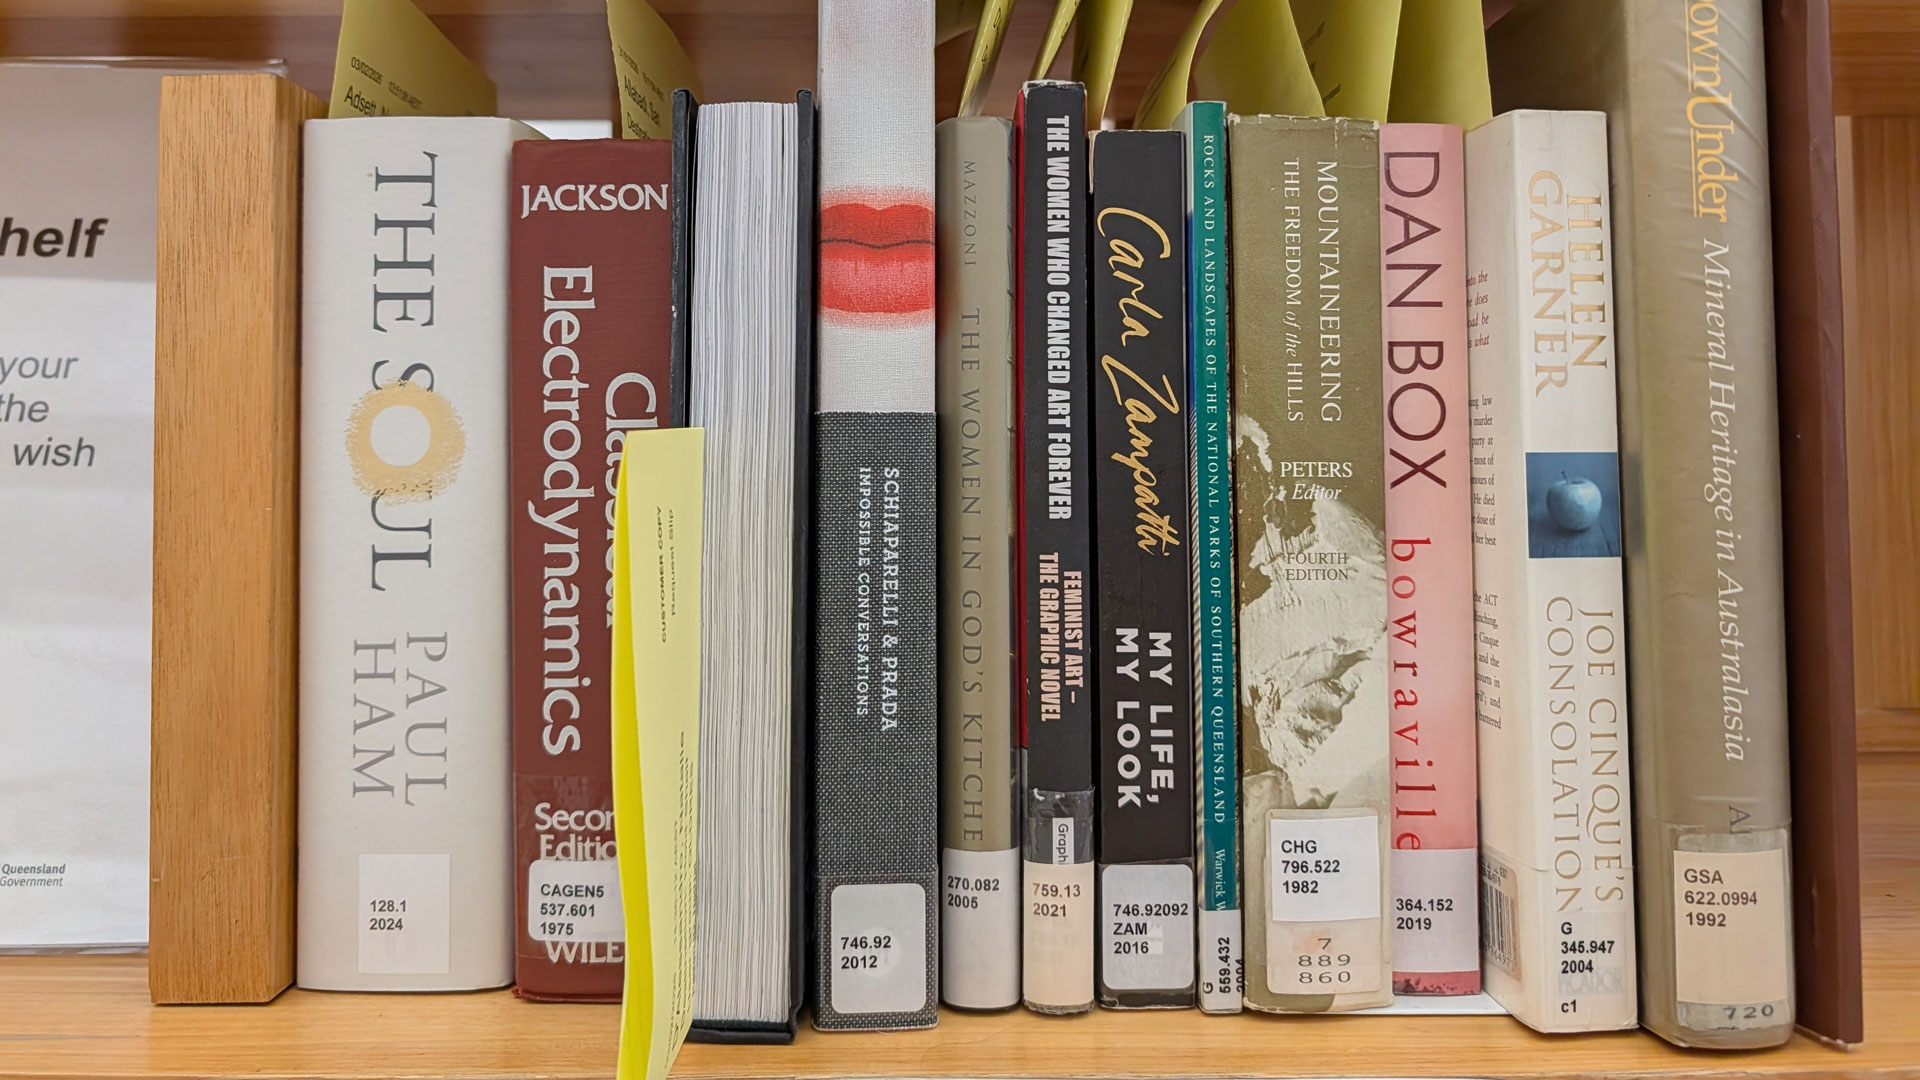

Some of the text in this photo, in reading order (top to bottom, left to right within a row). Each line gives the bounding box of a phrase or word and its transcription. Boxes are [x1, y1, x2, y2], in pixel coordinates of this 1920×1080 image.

[521, 184, 668, 219] JACKSON
[963, 160, 977, 266] MAZZONI
[0, 217, 109, 258] helf
[1478, 269, 1488, 284] the
[1528, 170, 1568, 397] GARNER
[1567, 194, 1608, 369] HELEN
[1283, 157, 1303, 422] THE FREEDOM of the HILLS
[1317, 160, 1342, 422] MOUNTAINEERING
[1475, 292, 1489, 306] does
[1703, 237, 1735, 372] Mineral
[1046, 115, 1072, 521] THE WOMEN WHO CHANGED ART FOREVER
[1384, 152, 1447, 489] DAN BOX
[1481, 311, 1489, 325] be
[1474, 333, 1490, 347] what
[0, 356, 79, 384] your
[347, 151, 464, 591] THE SOUL
[1097, 206, 1180, 557] Carla Zampatti
[1482, 394, 1493, 406] law
[1473, 413, 1493, 427] murder
[1471, 437, 1494, 449] party at
[1703, 378, 1738, 519] Heritage
[13, 436, 96, 467] wish
[1473, 453, 1494, 466] most of
[1280, 461, 1352, 478] PETERS
[1203, 134, 1225, 824] ROCKS AND LANDSCAPES OF THE NATIONAL PARKS OF SOUTHERN QUEENSLAND
[1488, 473, 1495, 486] of
[1291, 483, 1341, 500] Editor
[1473, 493, 1496, 506] He died
[528, 265, 596, 756] Electrodynamics
[1475, 512, 1488, 525] dose
[1489, 513, 1496, 526] of
[1475, 531, 1484, 545] her
[1484, 532, 1497, 546] best
[1714, 527, 1742, 562] in
[1286, 552, 1348, 565] FOURTH
[961, 308, 984, 842] THE WOMEN IN GOD'S KITCHE
[1286, 568, 1348, 581] EDITION
[659, 554, 667, 643] CUSTOMER
[856, 467, 872, 716] IMPOSSIBLE CONVERSATIONS
[880, 467, 900, 732] SCHIAPARELLI & PRADA
[1484, 593, 1499, 607] ACT
[1063, 570, 1083, 650] FEMINIST
[1039, 552, 1061, 721] THE GRAPHIC NOVEL
[1479, 631, 1500, 649] Cinque
[1479, 652, 1489, 665] and
[1490, 654, 1500, 668] the
[1717, 566, 1751, 762] Australasia
[1065, 652, 1084, 687] ART
[1493, 675, 1501, 689] in
[1390, 536, 1438, 849] bowraville
[1489, 697, 1501, 709] and
[352, 639, 397, 798] HAM
[405, 631, 448, 807] PAUL
[1115, 627, 1142, 808] MY LOOK
[1147, 631, 1175, 804] MY LIFE,
[1478, 708, 1502, 730] battered
[1546, 596, 1583, 912] CONSOLATION
[1578, 607, 1624, 902] JOE CINQUE'S
[540, 833, 617, 861] Editio
[1056, 823, 1069, 865] Graphi
[1281, 840, 1317, 854] CHG
[2, 863, 66, 875] Queensland
[1215, 848, 1226, 898] Warwick
[1281, 860, 1340, 874] 796.522
[0, 876, 63, 887] Government
[947, 875, 1000, 891] 270.082
[1684, 868, 1724, 885] GSA
[540, 883, 605, 898] CAGEN5
[1032, 882, 1081, 898] 759.13
[1282, 880, 1319, 894] 1982
[369, 899, 408, 913] 128.1
[1395, 897, 1453, 912] 364.152
[1684, 890, 1758, 906] 622.0994
[540, 902, 595, 917] 537.601
[1032, 902, 1067, 918] 2021
[1113, 902, 1189, 918] 746.92092
[369, 917, 404, 932] 2024
[1395, 916, 1433, 931] 2019
[1685, 911, 1727, 927] 1992
[540, 921, 574, 936] 1975
[1112, 922, 1148, 936] ZAM
[1560, 921, 1573, 935] G
[840, 935, 892, 950] 746.92
[1113, 941, 1149, 955] 2016
[1317, 937, 1332, 950] 7
[1560, 940, 1615, 954] 345.947
[545, 940, 625, 964] WILE
[840, 955, 878, 970] 2012
[1218, 936, 1231, 994] 559.432
[1560, 959, 1594, 974] 2004
[1202, 981, 1214, 994] G
[1560, 999, 1577, 1013] c1
